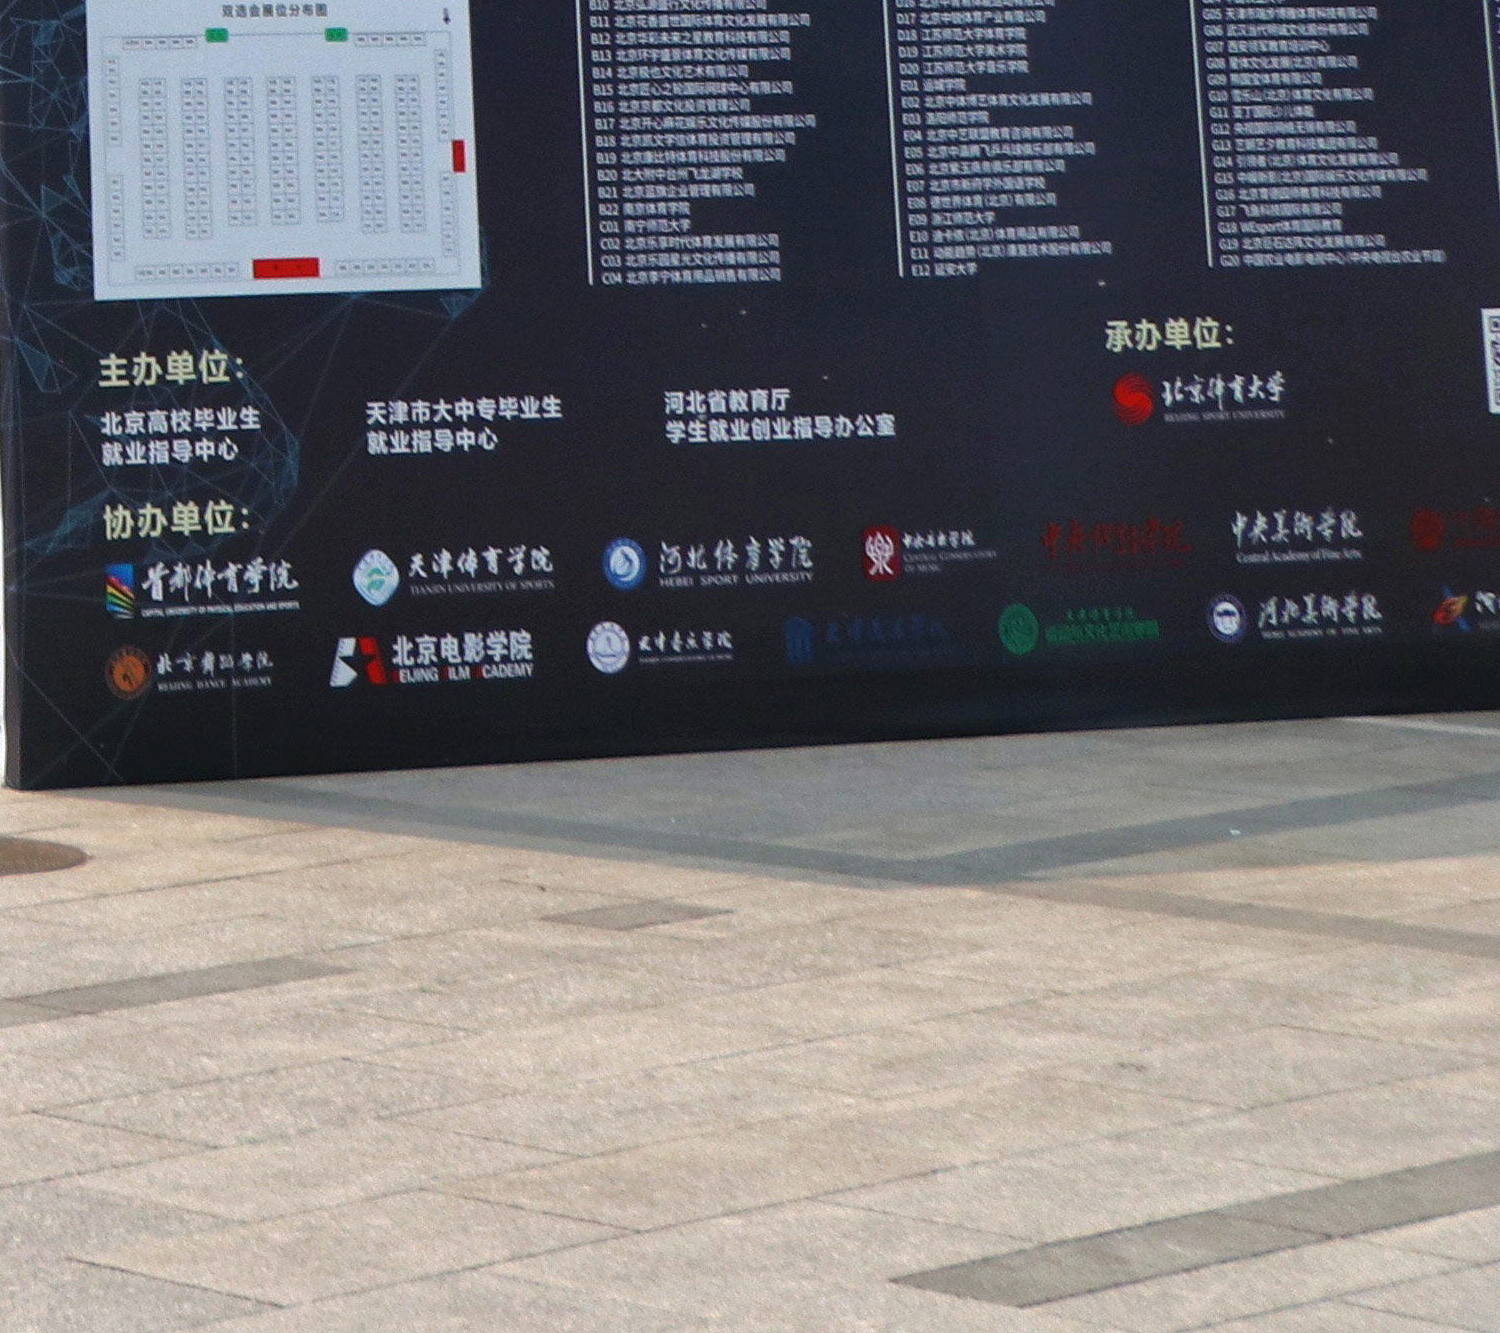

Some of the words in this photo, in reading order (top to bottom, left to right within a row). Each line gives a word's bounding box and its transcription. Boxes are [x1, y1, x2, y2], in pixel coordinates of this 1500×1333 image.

[365, 394, 564, 425] 天津市大中专毕业生
[664, 388, 791, 415] 河北省教育厅
[100, 406, 262, 437] 北京高校毕业生
[664, 413, 897, 445] 学生就业创业指导办公室
[101, 437, 240, 466] 就业指导中心
[366, 427, 499, 456] 就业指导中心
[700, 573, 739, 587] SPORT
[745, 571, 814, 585] UNIVERSITY
[392, 628, 534, 667] 北京电影学院
